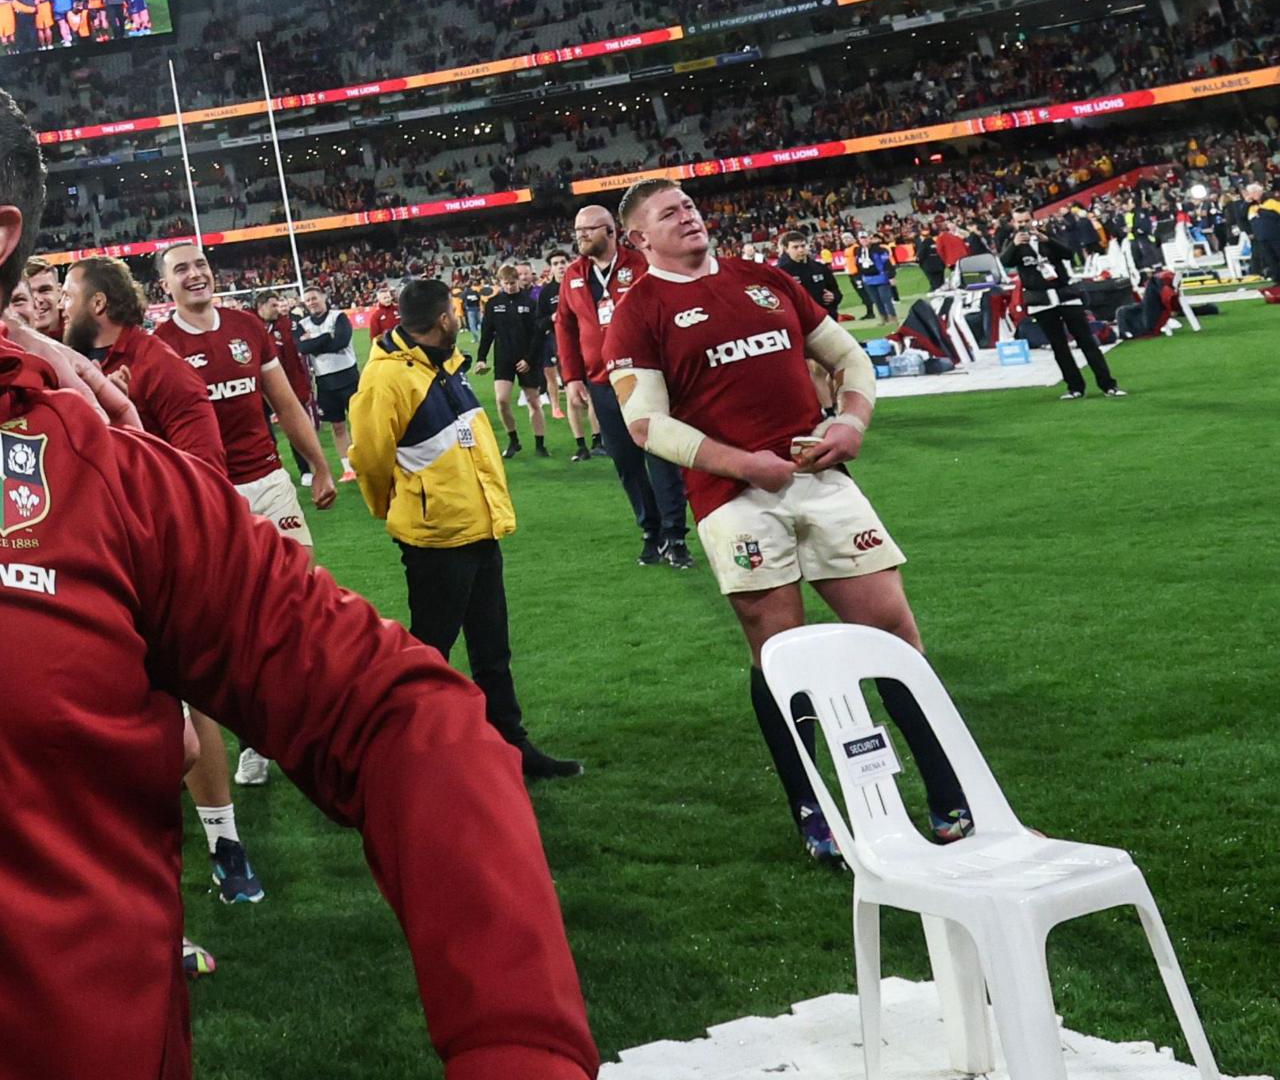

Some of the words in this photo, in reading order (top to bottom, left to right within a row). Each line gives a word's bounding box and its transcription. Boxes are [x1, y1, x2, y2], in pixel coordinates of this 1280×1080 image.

[604, 41, 620, 51] THE
[621, 37, 642, 48] LIONS
[346, 89, 360, 97] THE
[360, 85, 381, 95] LIONS
[1191, 77, 1251, 94] WALLABIES
[1073, 104, 1093, 115] THE
[1095, 99, 1124, 112] LIONS
[101, 125, 115, 133] THE
[116, 123, 135, 132] LIONS
[878, 131, 930, 146] WALLABIES
[773, 152, 790, 162] THE
[792, 148, 819, 160] LIONS
[445, 201, 460, 210] THE
[461, 198, 486, 209] LIONS
[275, 221, 317, 234] WALABIES
[706, 329, 791, 368] HOWDEN
[207, 376, 256, 400] OWDEN
[11, 538, 40, 549] 1888
[849, 738, 880, 754] SECURITY
